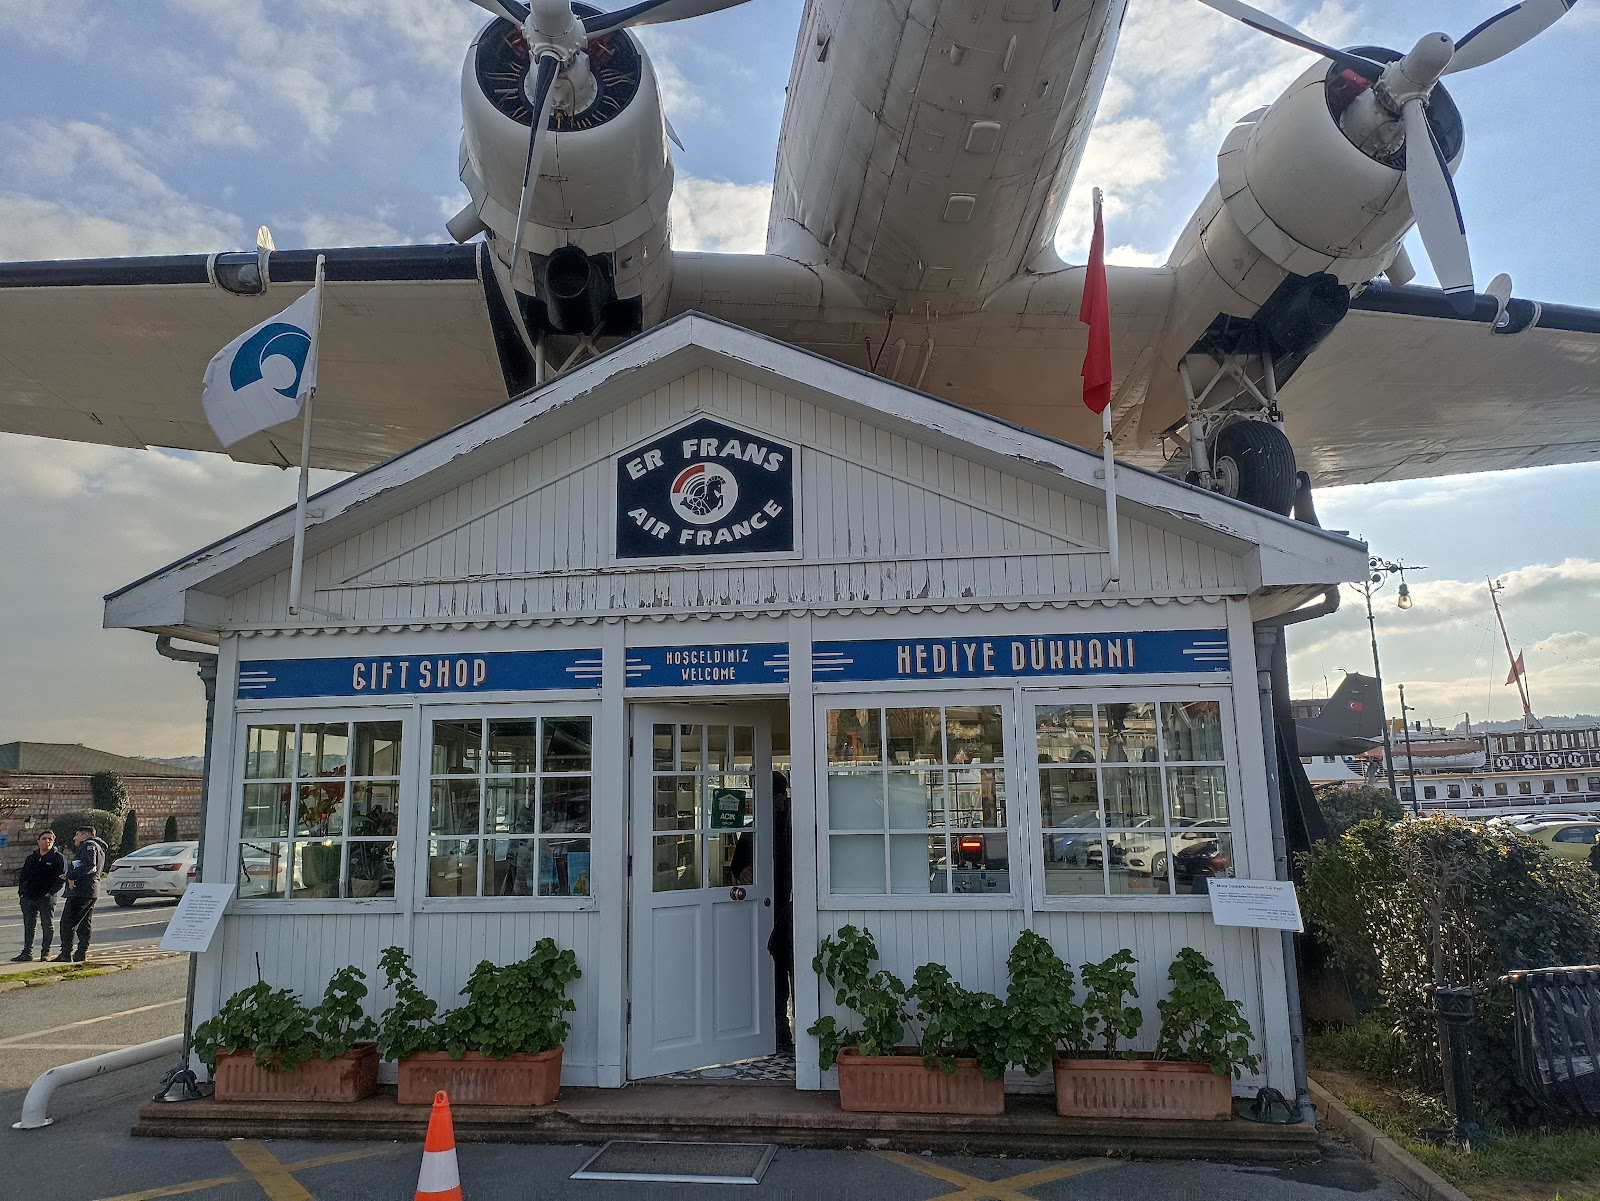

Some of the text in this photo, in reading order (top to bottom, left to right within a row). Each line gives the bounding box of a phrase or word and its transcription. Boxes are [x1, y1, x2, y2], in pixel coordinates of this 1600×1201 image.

[625, 437, 784, 481] ER FRANS
[627, 499, 783, 546] AIR FRANCE
[681, 666, 736, 681] WELCOME
[897, 638, 1136, 674] HEDİYE DÜKKANI
[352, 659, 487, 690] GIFT SHOP
